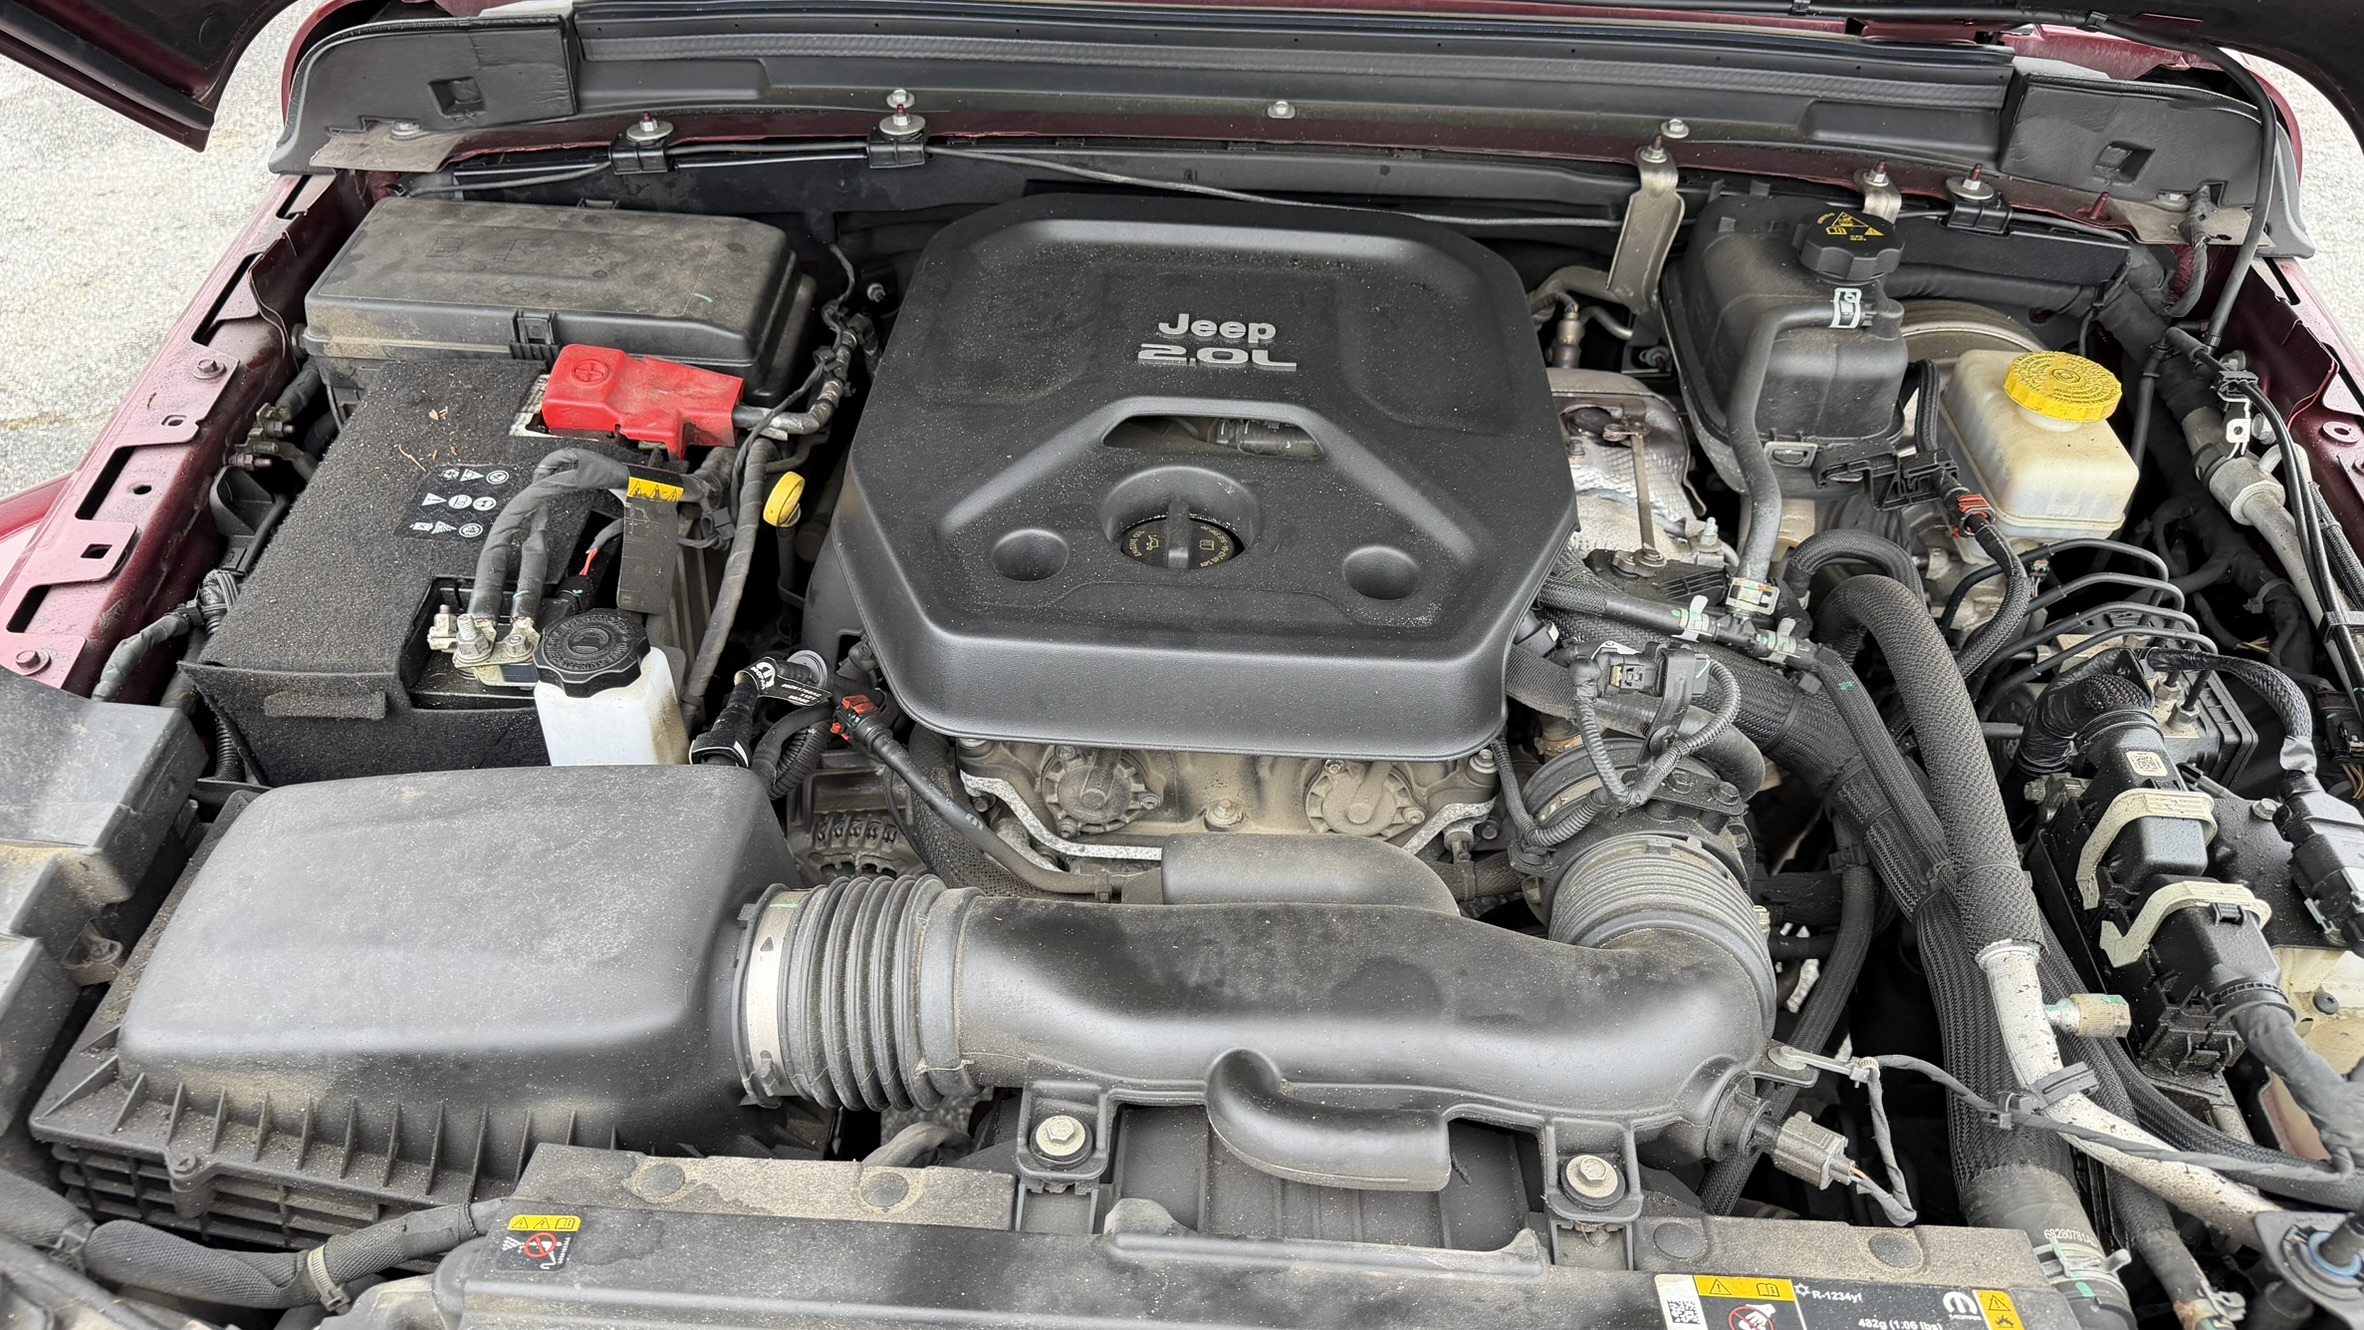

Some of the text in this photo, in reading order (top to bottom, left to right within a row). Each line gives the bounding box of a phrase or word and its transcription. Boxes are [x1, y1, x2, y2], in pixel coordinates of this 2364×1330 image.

[1158, 313, 1277, 344] Jeep
[1137, 343, 1298, 370] 2.0L
[1812, 1290, 1862, 1303] R-1234yf
[1858, 1318, 1888, 1330] 482g
